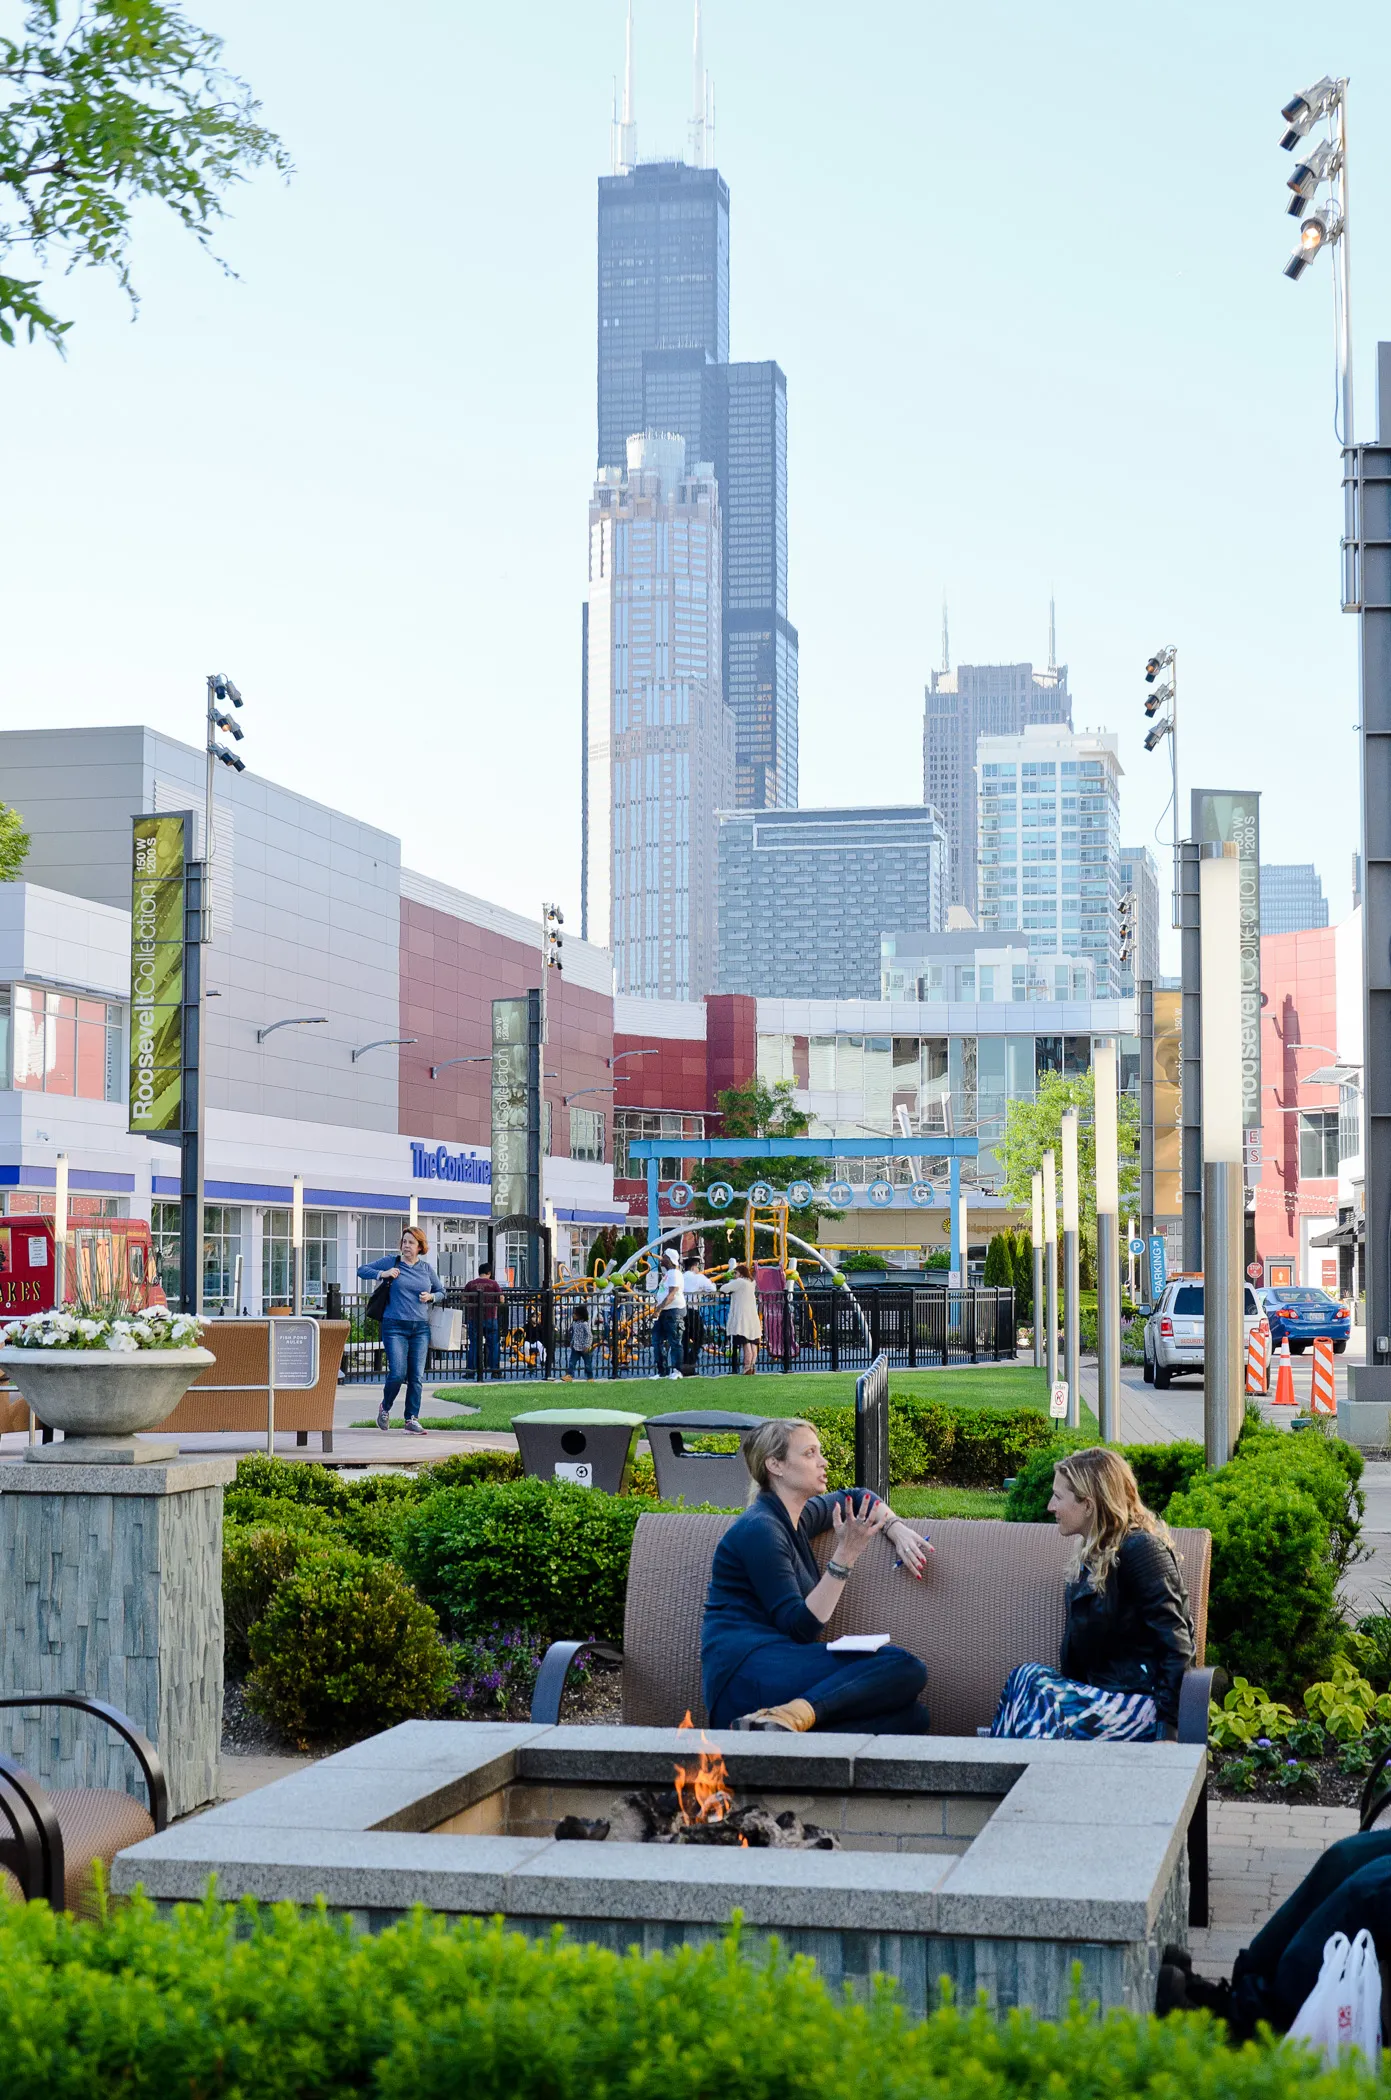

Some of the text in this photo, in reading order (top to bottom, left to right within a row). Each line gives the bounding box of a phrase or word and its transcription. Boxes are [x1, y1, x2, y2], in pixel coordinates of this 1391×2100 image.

[1244, 815, 1256, 856] 1200 S
[136, 838, 147, 873] 150 W
[146, 837, 157, 875] 1200 S
[436, 1145, 492, 1184] Containe
[675, 1185, 928, 1203] PARKING
[1133, 1242, 1141, 1251] P
[1152, 1247, 1163, 1293] PARKING
